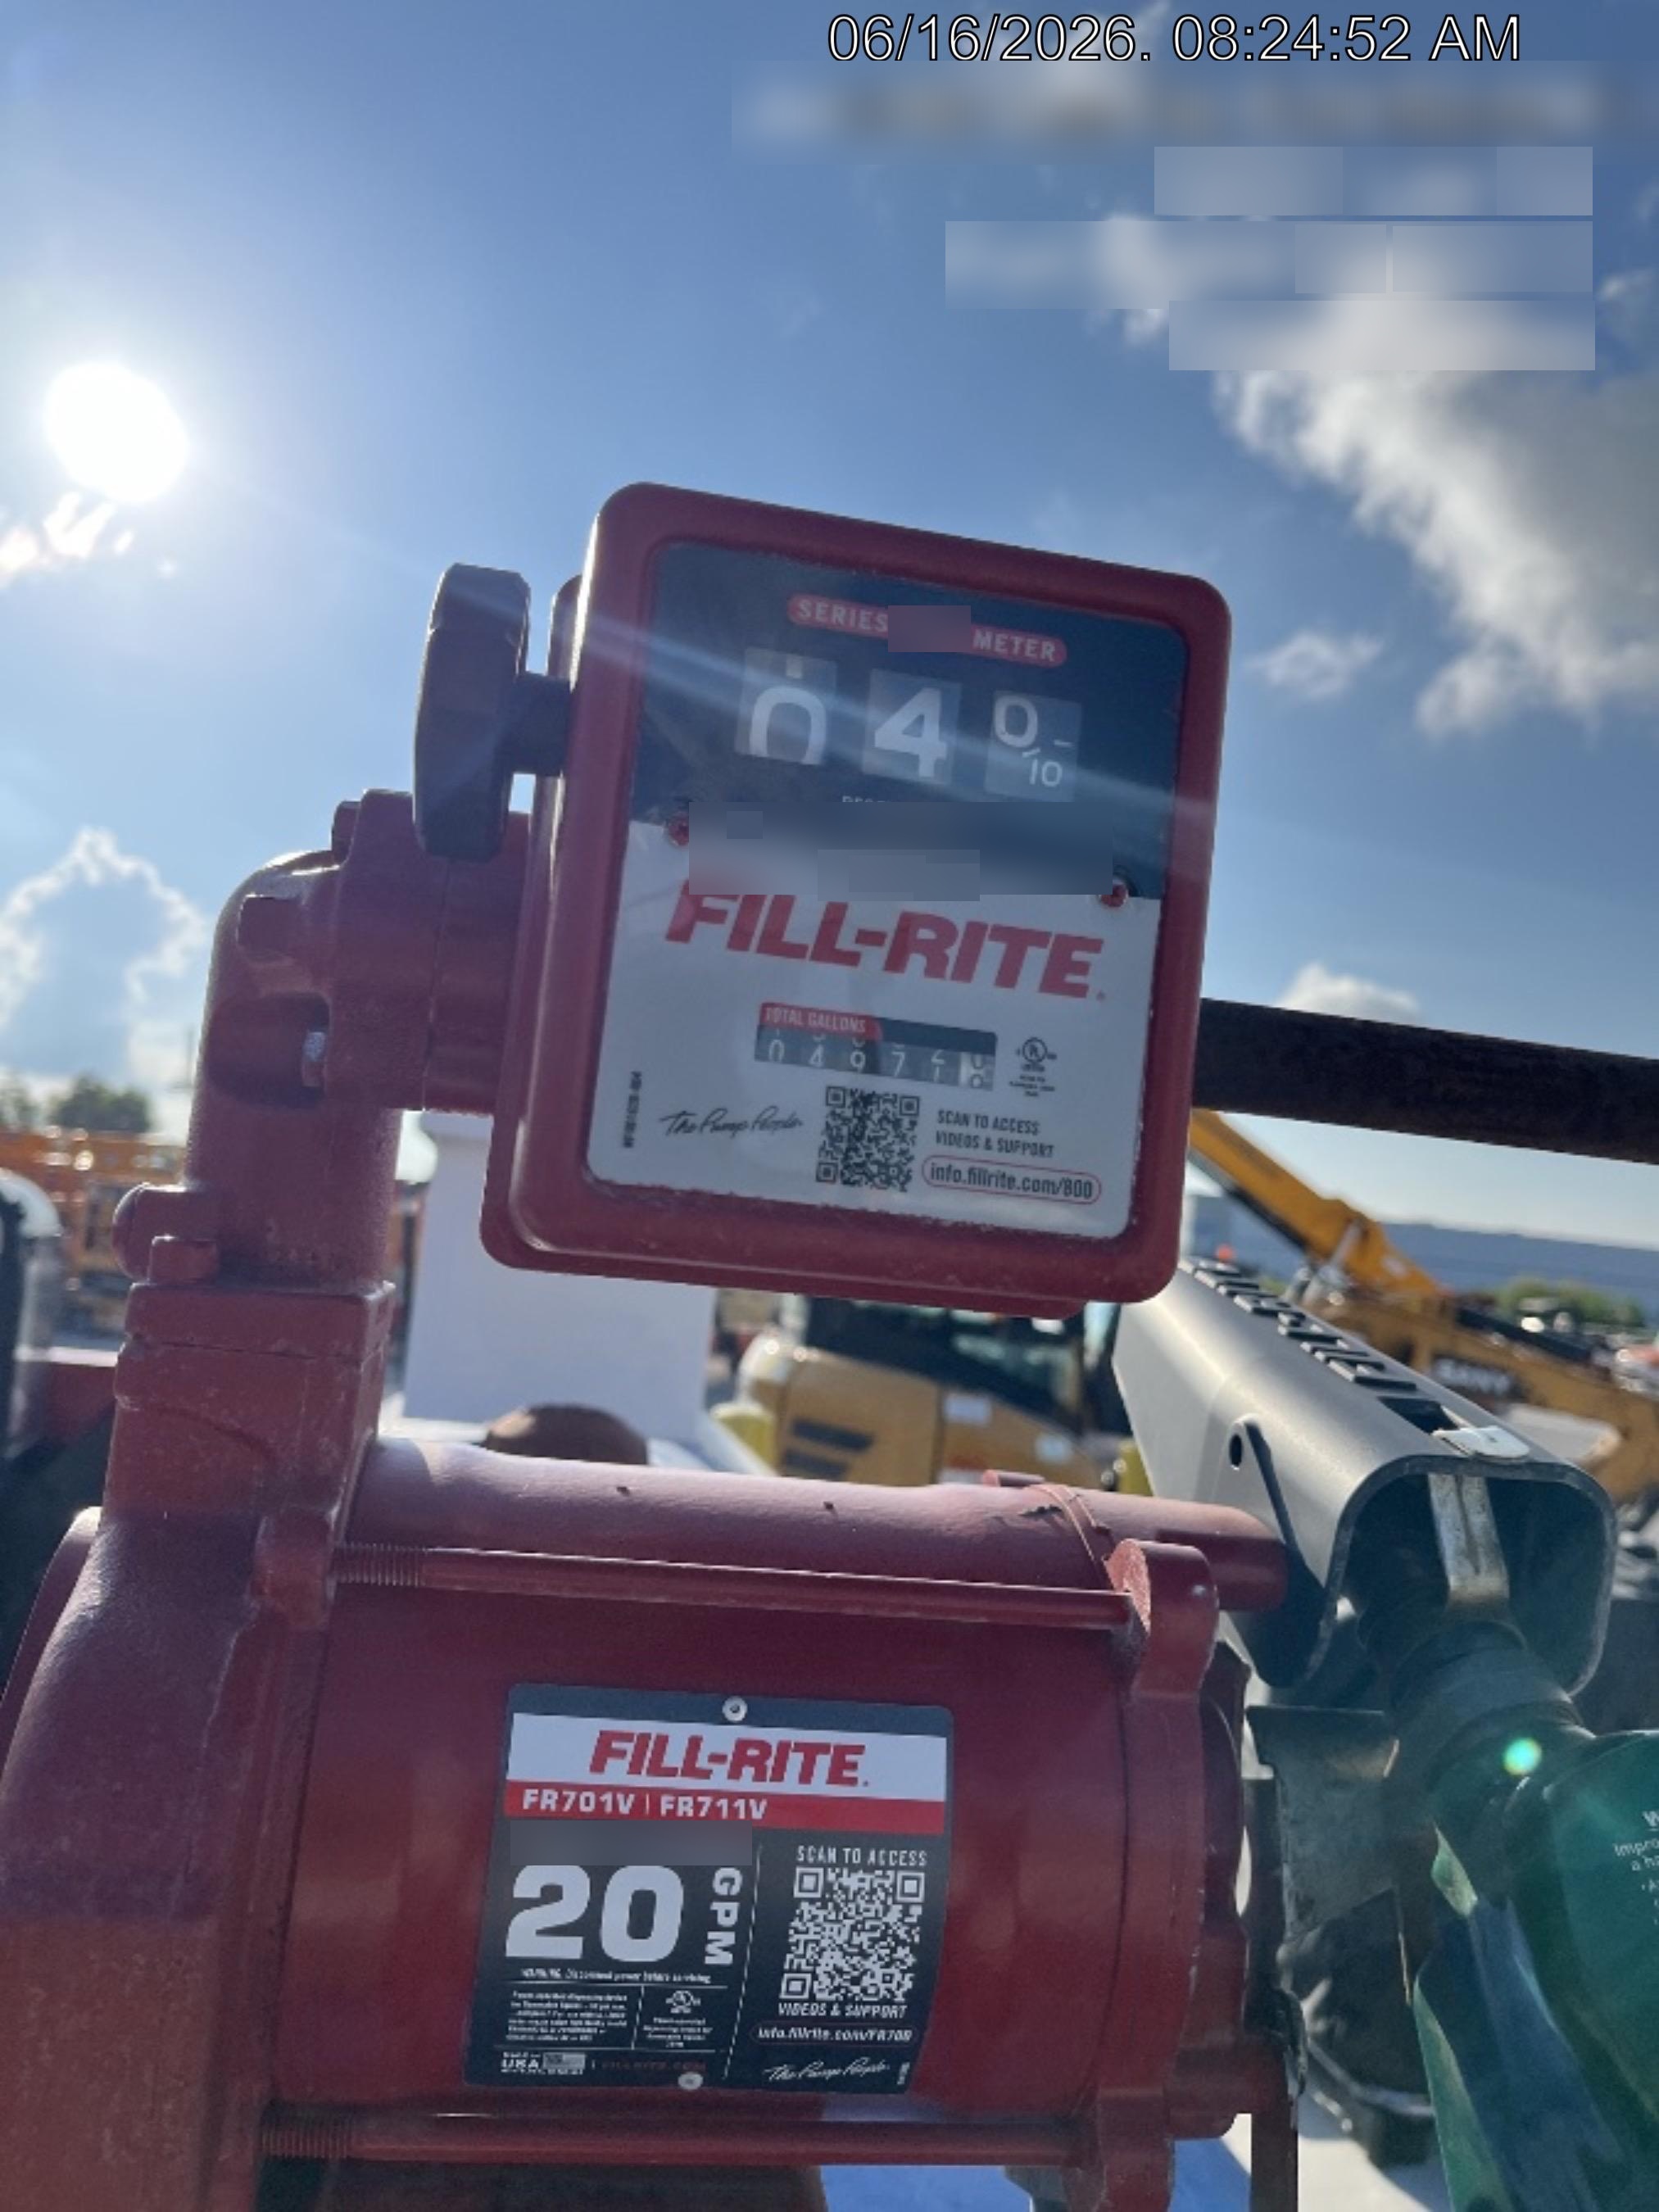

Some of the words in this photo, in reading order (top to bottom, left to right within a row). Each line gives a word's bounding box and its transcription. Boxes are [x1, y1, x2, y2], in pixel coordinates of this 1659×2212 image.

[799, 599, 888, 632] SERIES
[973, 629, 1055, 661] METER
[665, 879, 1104, 998] FILL-RITE
[765, 1007, 803, 1026] TOTAL
[808, 1012, 866, 1032] GALLONS
[659, 1110, 697, 1135] The
[938, 1110, 969, 1126] SCAN
[975, 1113, 989, 1128] TO
[992, 1116, 1040, 1135] ACCESS
[936, 1131, 979, 1149] VIDEOS
[984, 1136, 993, 1150] &
[997, 1138, 1054, 1158] SUPPORT
[931, 1163, 1093, 1199] info.fillrite.com/800
[589, 1729, 866, 1787] FILL-RITE
[523, 1788, 635, 1816] FR701V
[660, 1795, 767, 1820] FR711V
[796, 1845, 836, 1863] SCAN
[842, 1847, 860, 1863] TO
[868, 1848, 927, 1866] ACCESS
[505, 1865, 684, 1961] 20
[705, 1867, 742, 1965] GPM
[778, 2002, 827, 2016] VIDEOS
[830, 2003, 841, 2016] &
[845, 2005, 908, 2019] SUPPORT
